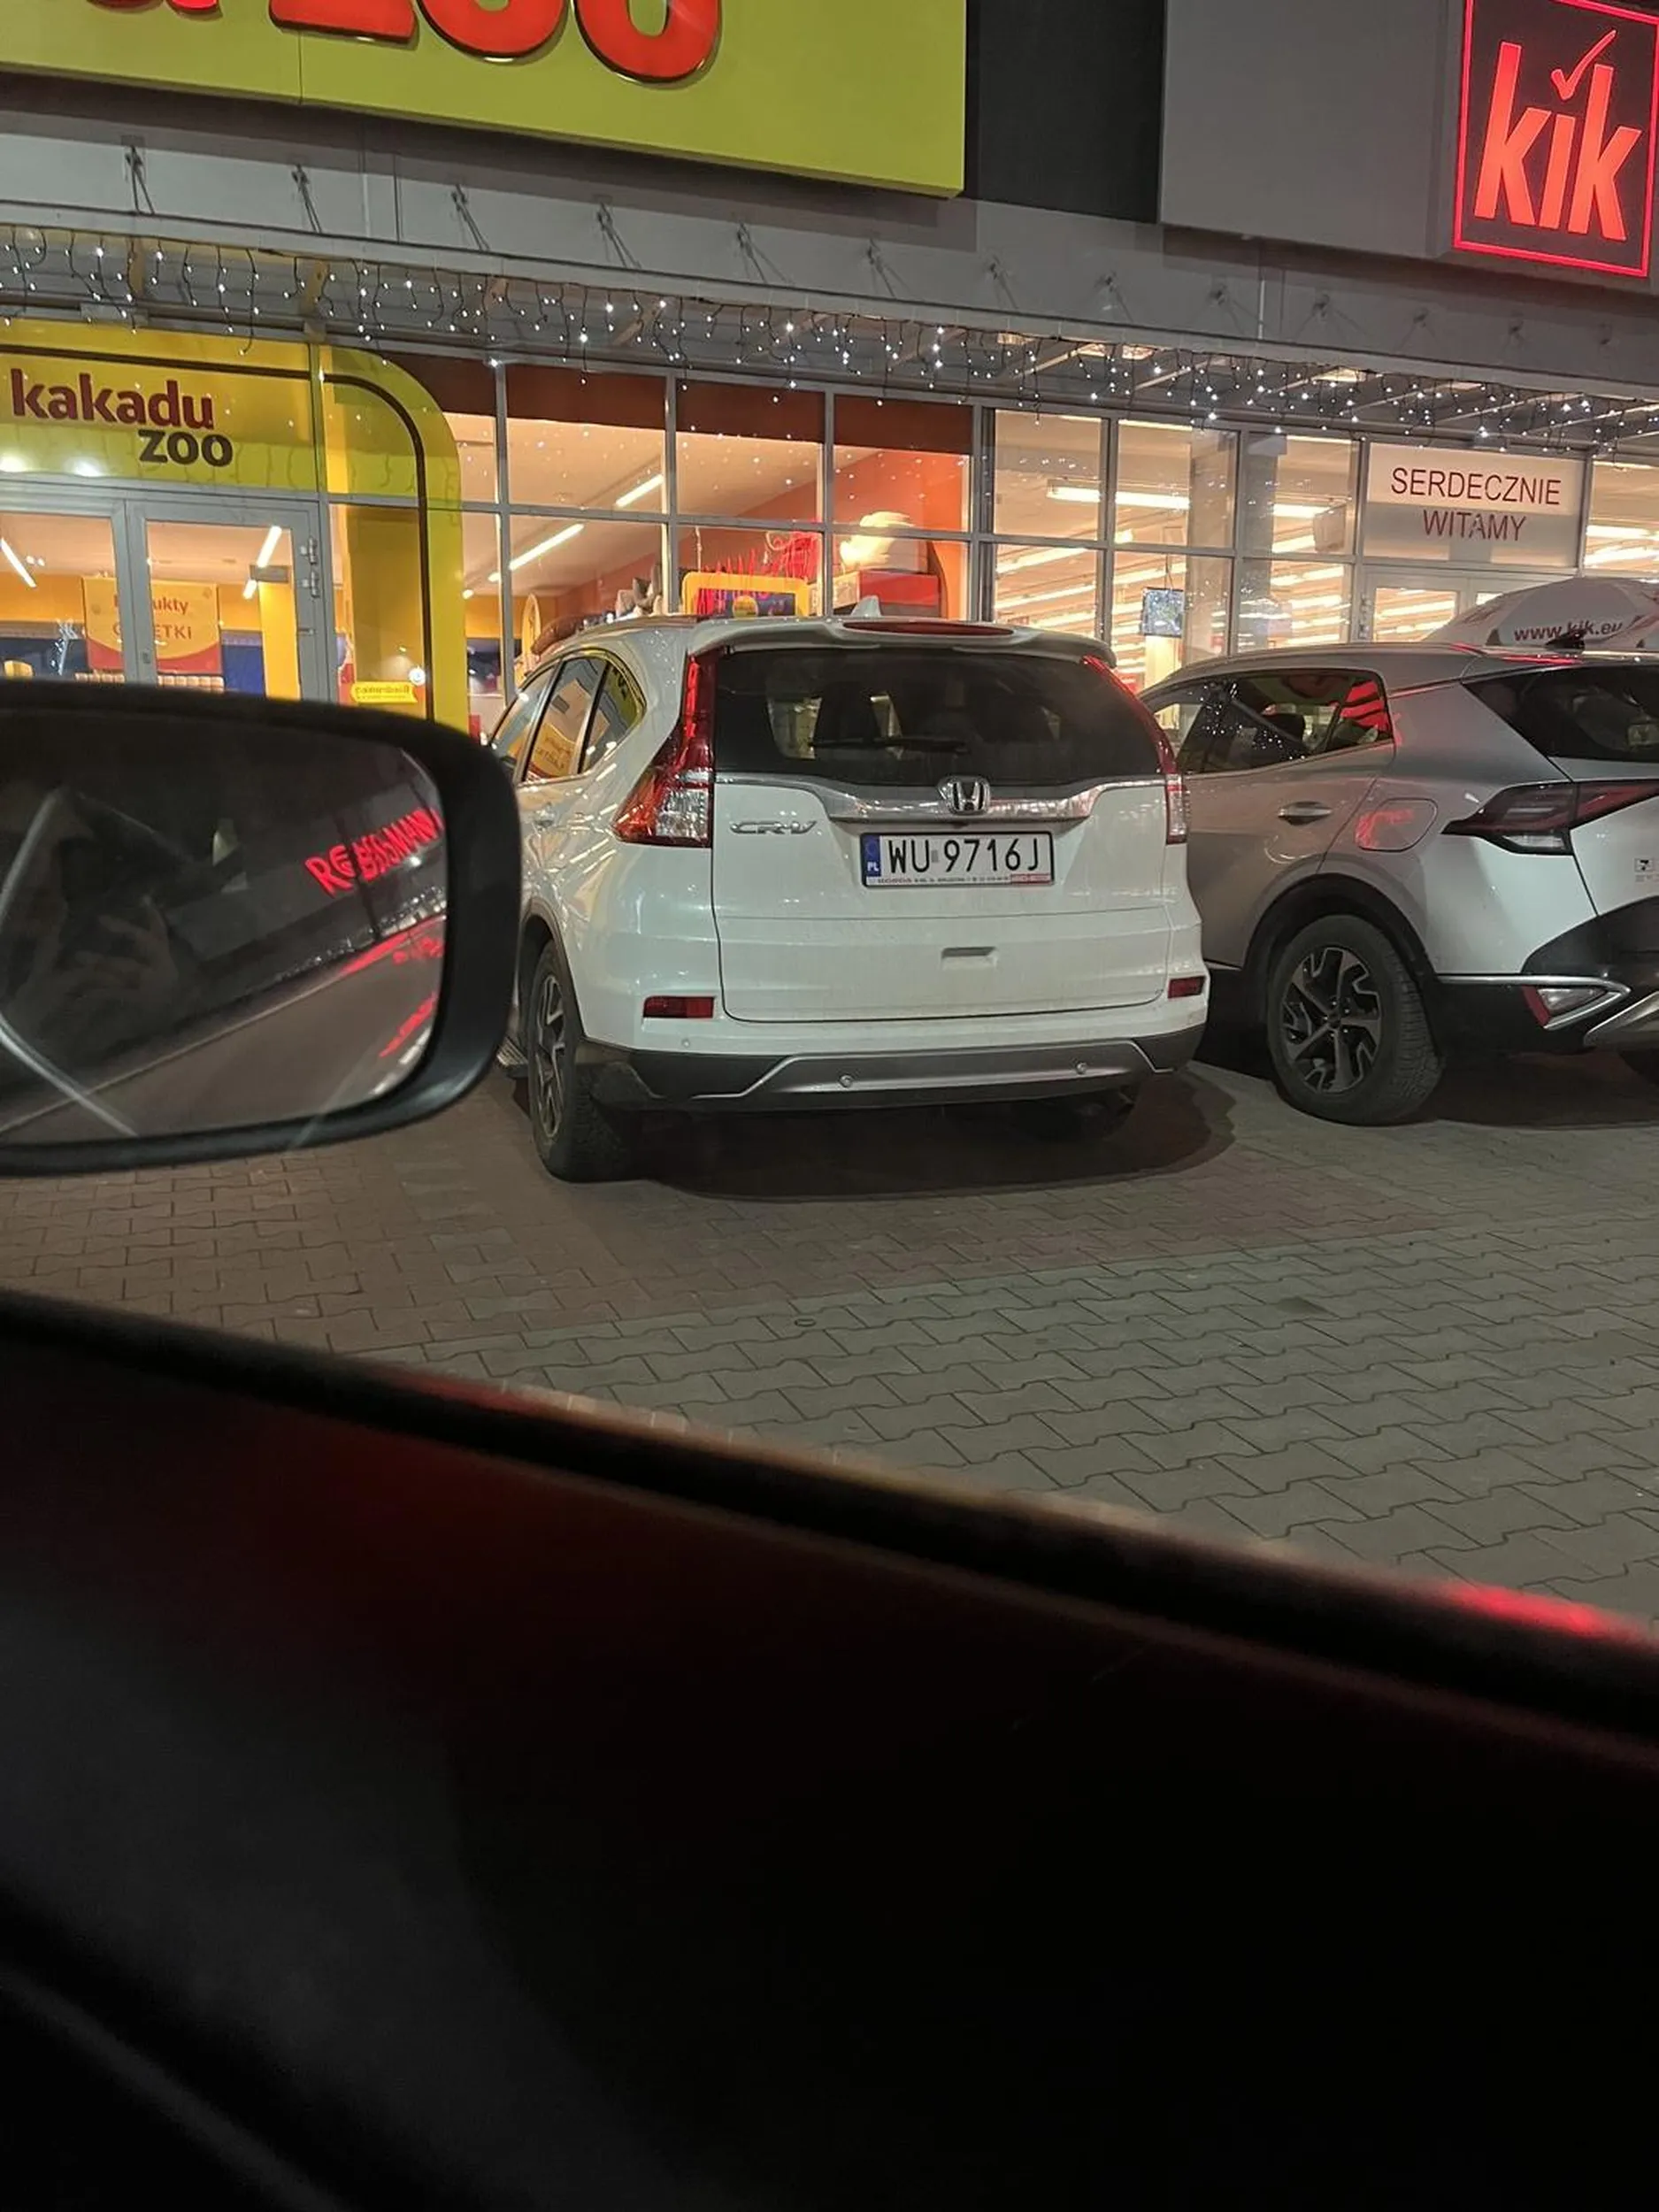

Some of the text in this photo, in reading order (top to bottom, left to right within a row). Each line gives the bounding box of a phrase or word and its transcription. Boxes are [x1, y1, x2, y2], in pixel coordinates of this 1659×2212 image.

[1474, 30, 1642, 242] kik
[10, 367, 214, 430] kakadu
[137, 428, 234, 467] zoo
[1391, 467, 1562, 505] SERDECZNIE
[1423, 509, 1526, 541] WITAMY
[1514, 619, 1623, 641] wwwkik.eu
[888, 838, 1040, 873] WU 9716J
